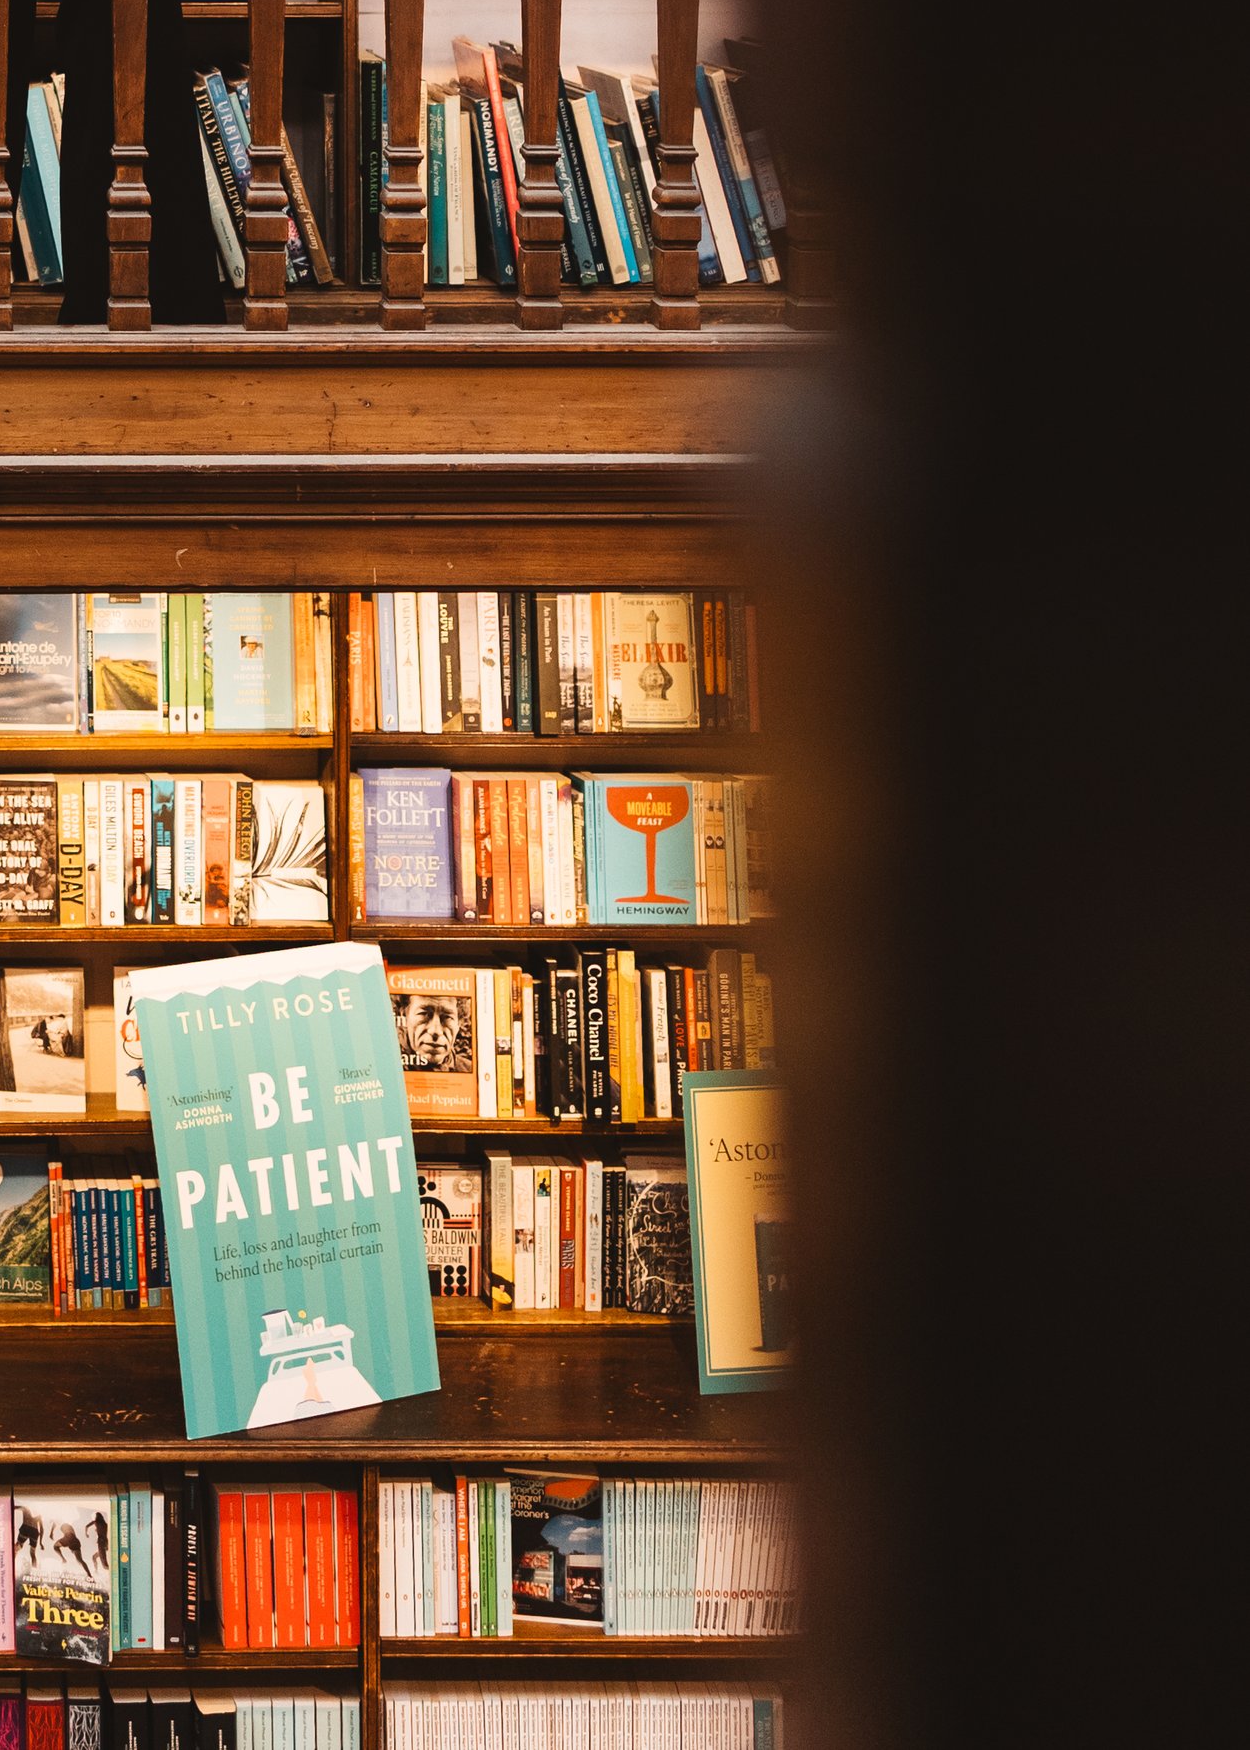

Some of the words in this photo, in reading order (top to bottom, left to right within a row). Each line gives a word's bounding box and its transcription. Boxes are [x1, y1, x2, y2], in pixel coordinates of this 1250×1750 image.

[211, 100, 252, 170] URBINO
[476, 101, 500, 173] NORMANDY
[440, 603, 448, 644] LOUVRE
[39, 642, 56, 653] de
[350, 631, 362, 665] PARIS
[622, 644, 688, 663] ELIXIR
[8, 794, 28, 808] THE
[30, 794, 52, 808] SEA
[387, 791, 423, 806] KEN
[477, 786, 485, 808] JULIAN
[645, 792, 653, 800] A
[132, 793, 143, 825] SWORD
[367, 807, 445, 827] FOLLETT
[626, 802, 671, 816] MOVEABLE
[12, 812, 45, 826] ALIVE
[478, 809, 486, 834] BARNES
[636, 817, 663, 826] FEAST
[11, 840, 37, 852] ORAL
[133, 828, 145, 859] BEACH
[374, 856, 445, 870] NOTRE-
[60, 842, 84, 906] D-DAY
[379, 872, 437, 887] DAME
[616, 906, 689, 916] HEMINGWAY
[390, 973, 470, 992] Giacometti
[587, 963, 602, 1005] Coco
[177, 1001, 258, 1034] TILLY
[273, 988, 354, 1019] ROSE
[566, 989, 576, 1045] CHANEL
[588, 1009, 604, 1062] Chanel
[674, 1022, 684, 1047] LOVE
[334, 1079, 382, 1095] GIOVANNA
[334, 1089, 384, 1104] FLETCHER
[248, 1065, 314, 1130] BE
[175, 1113, 233, 1130] ASHWORTH
[183, 1105, 223, 1119] DONNA
[175, 1136, 404, 1229] PATIENT
[213, 1244, 241, 1263] Life,
[243, 1238, 268, 1257] loss
[271, 1235, 293, 1253] and
[296, 1226, 349, 1250] laughter
[351, 1220, 381, 1236] from
[432, 1229, 478, 1245] BALDWIN
[215, 1261, 259, 1283] behind
[262, 1258, 283, 1274] the
[286, 1249, 336, 1276] hospital
[339, 1241, 384, 1261] curtain
[437, 1255, 463, 1264] SEINE
[562, 1239, 574, 1270] PARIS
[12, 1275, 43, 1292] Alps
[517, 1502, 533, 1510] the
[459, 1527, 466, 1541] AM
[22, 1598, 104, 1630] Three
